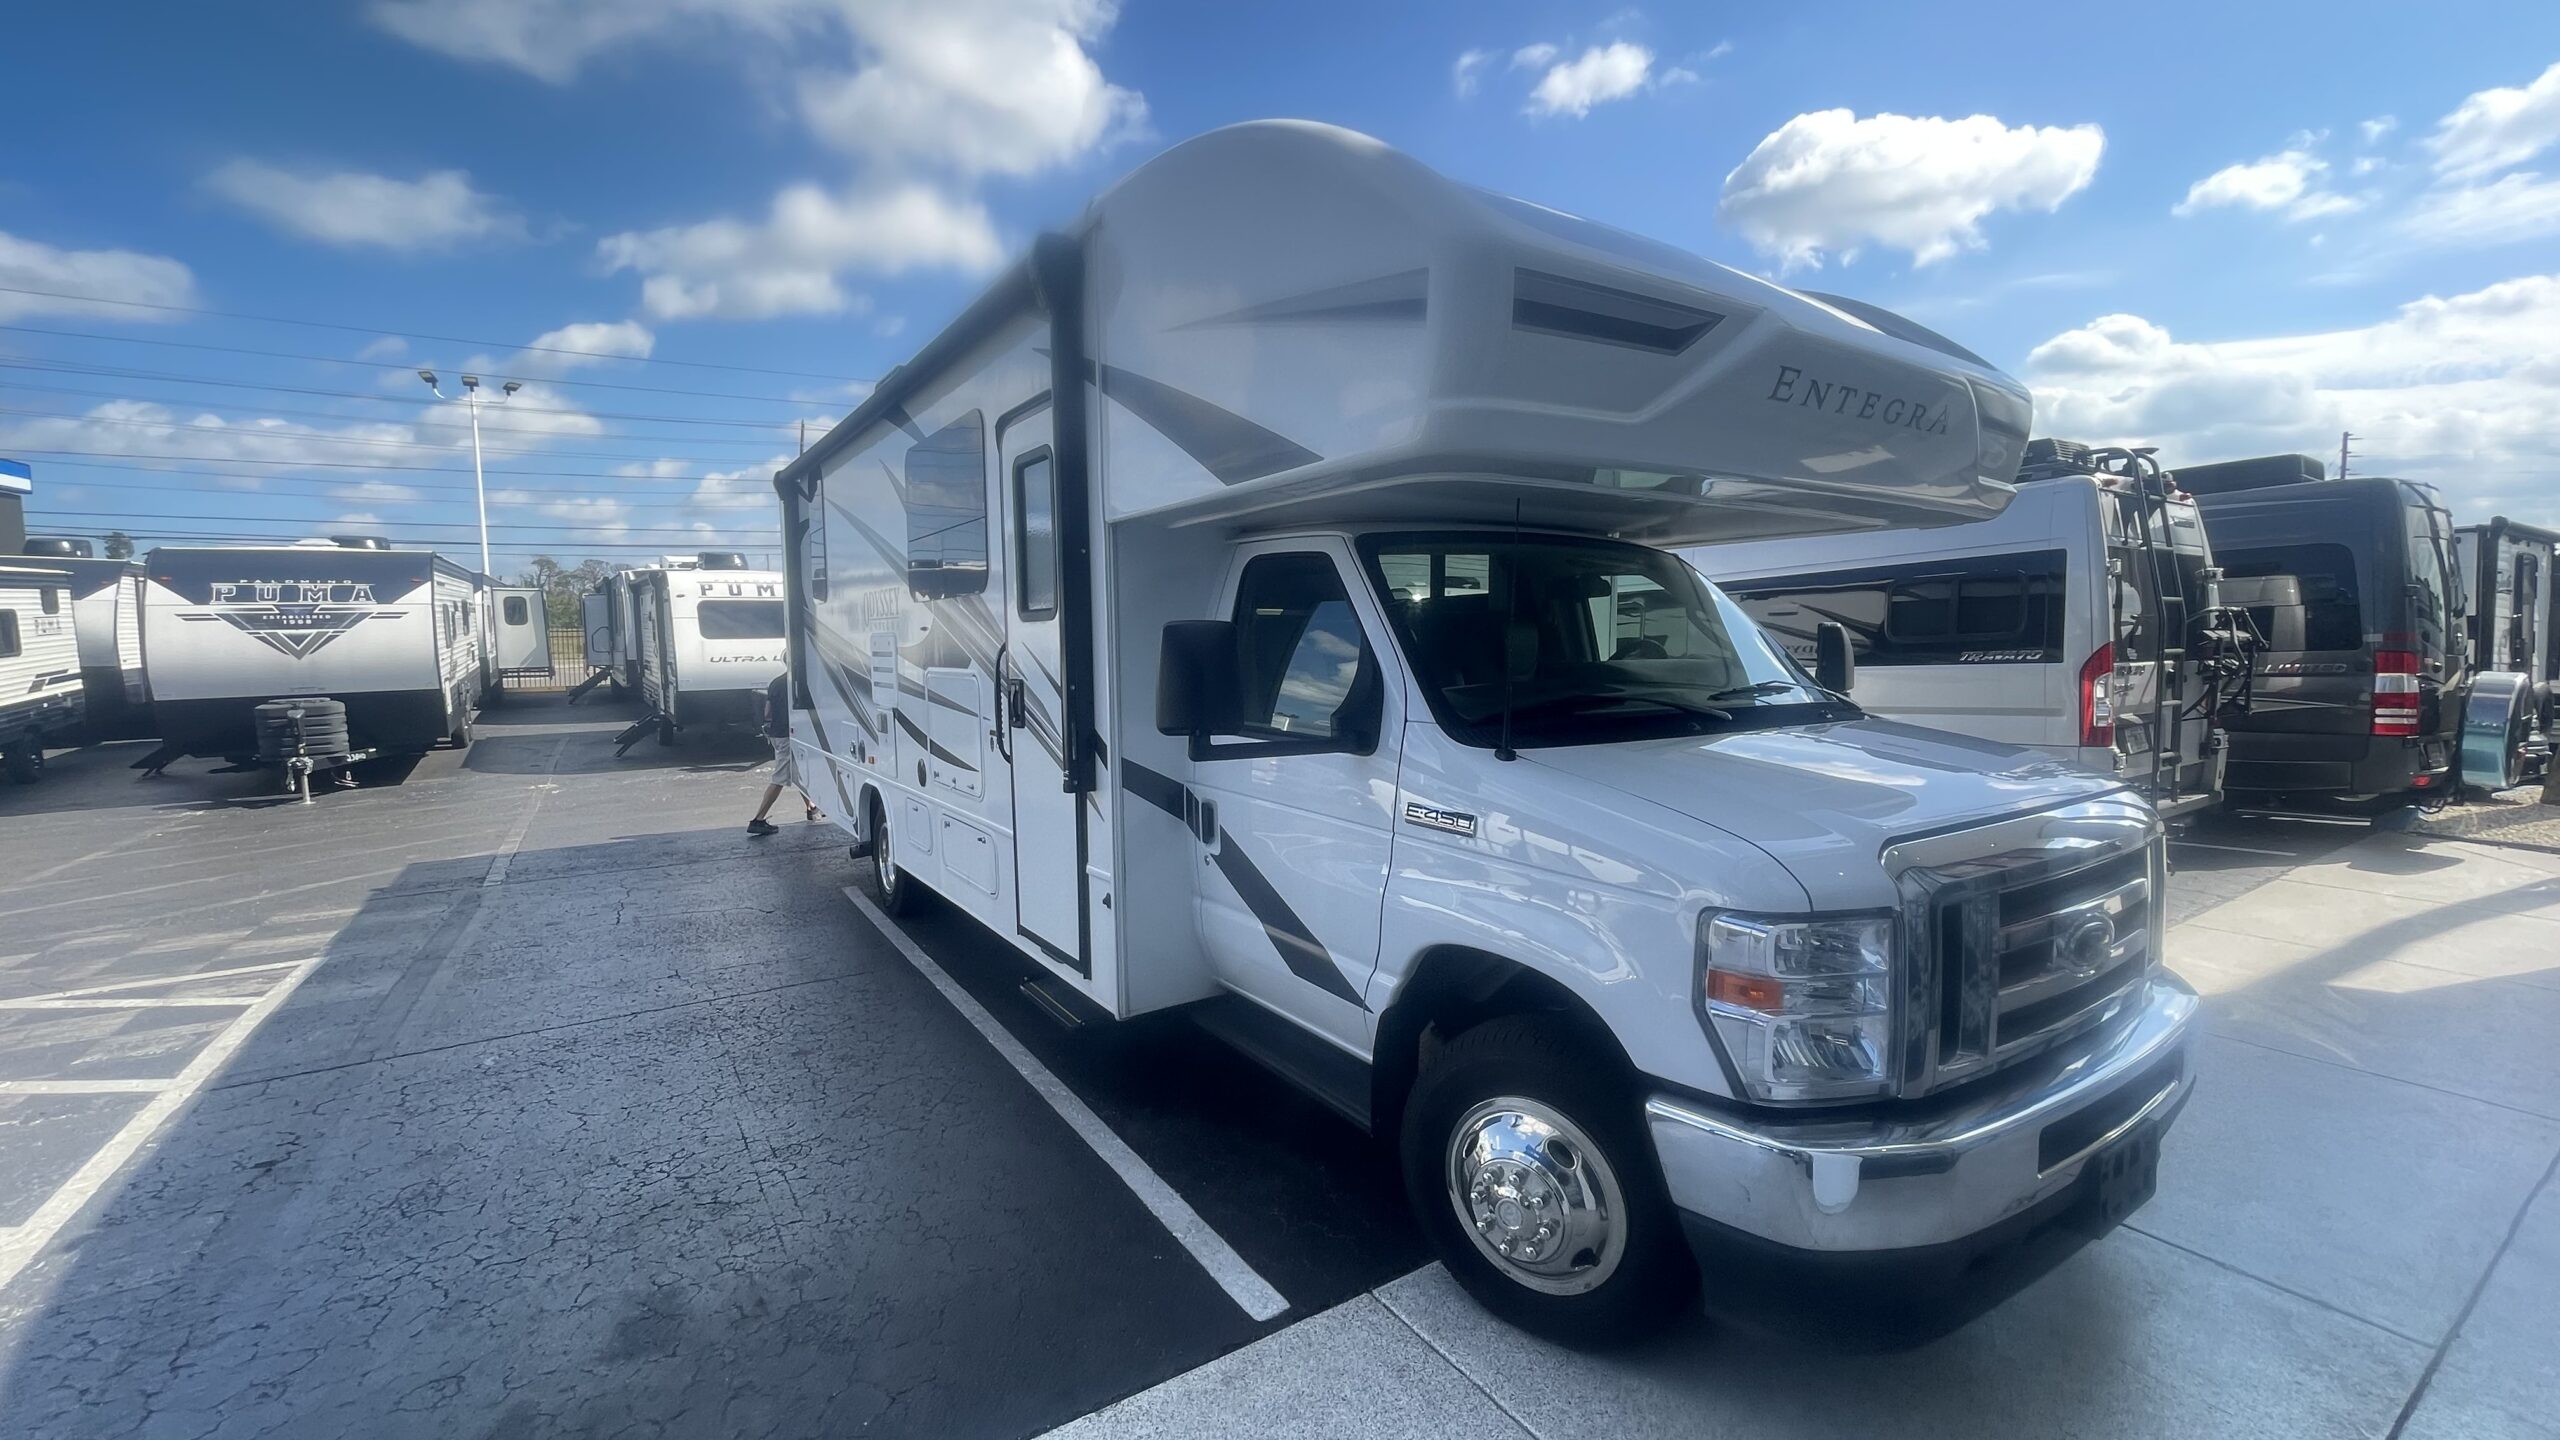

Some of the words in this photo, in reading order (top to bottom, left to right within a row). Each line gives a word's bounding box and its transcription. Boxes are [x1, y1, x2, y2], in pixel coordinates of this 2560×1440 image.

[1768, 365, 1949, 435] ENTEGRA
[209, 583, 377, 604] PUMA
[700, 583, 776, 597] PUM
[863, 587, 901, 627] ODYSSEY
[710, 655, 768, 663] ULTRA
[2264, 663, 2347, 673] LIMITED
